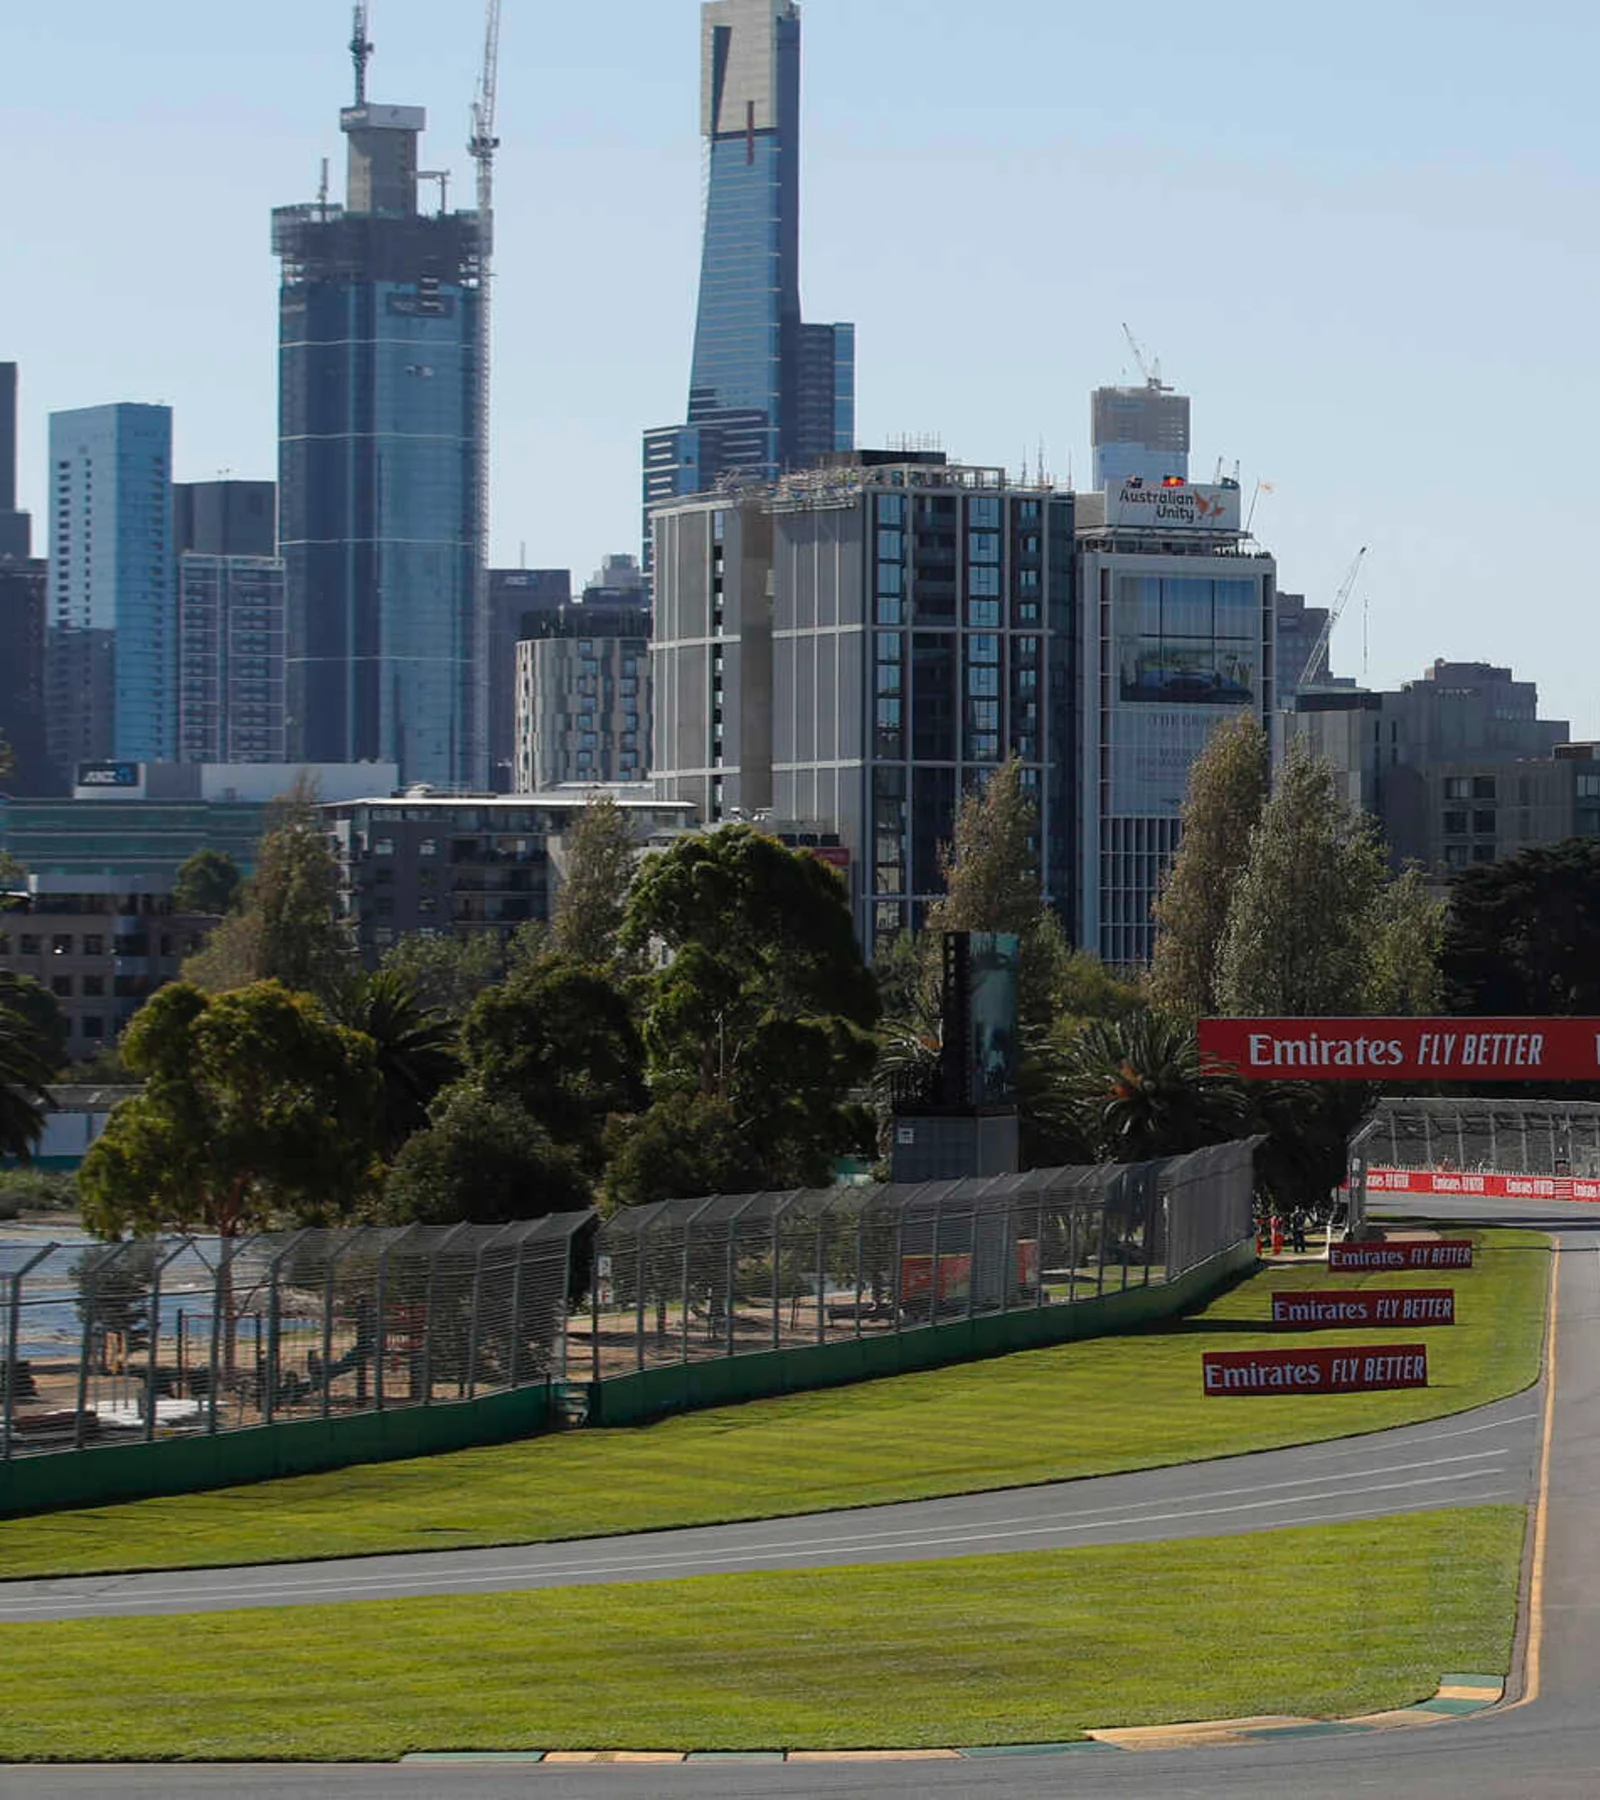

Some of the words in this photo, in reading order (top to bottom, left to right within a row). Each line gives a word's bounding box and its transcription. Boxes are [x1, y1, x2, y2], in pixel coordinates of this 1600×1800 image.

[1119, 489, 1194, 503] Australian
[1156, 504, 1195, 524] Unity
[1249, 1033, 1404, 1066] Emirates
[1417, 1033, 1455, 1066] FLY
[1460, 1033, 1545, 1066] BETTER
[1330, 1248, 1405, 1266] Emirates
[1411, 1248, 1430, 1264] FLY
[1431, 1247, 1471, 1264] BETTER
[1273, 1300, 1368, 1321] Emirates
[1376, 1299, 1399, 1320] FLY
[1402, 1297, 1452, 1319] BETTER
[1205, 1361, 1321, 1388] Emirates
[1332, 1358, 1359, 1383] FLY
[1364, 1355, 1425, 1382] BETTER
